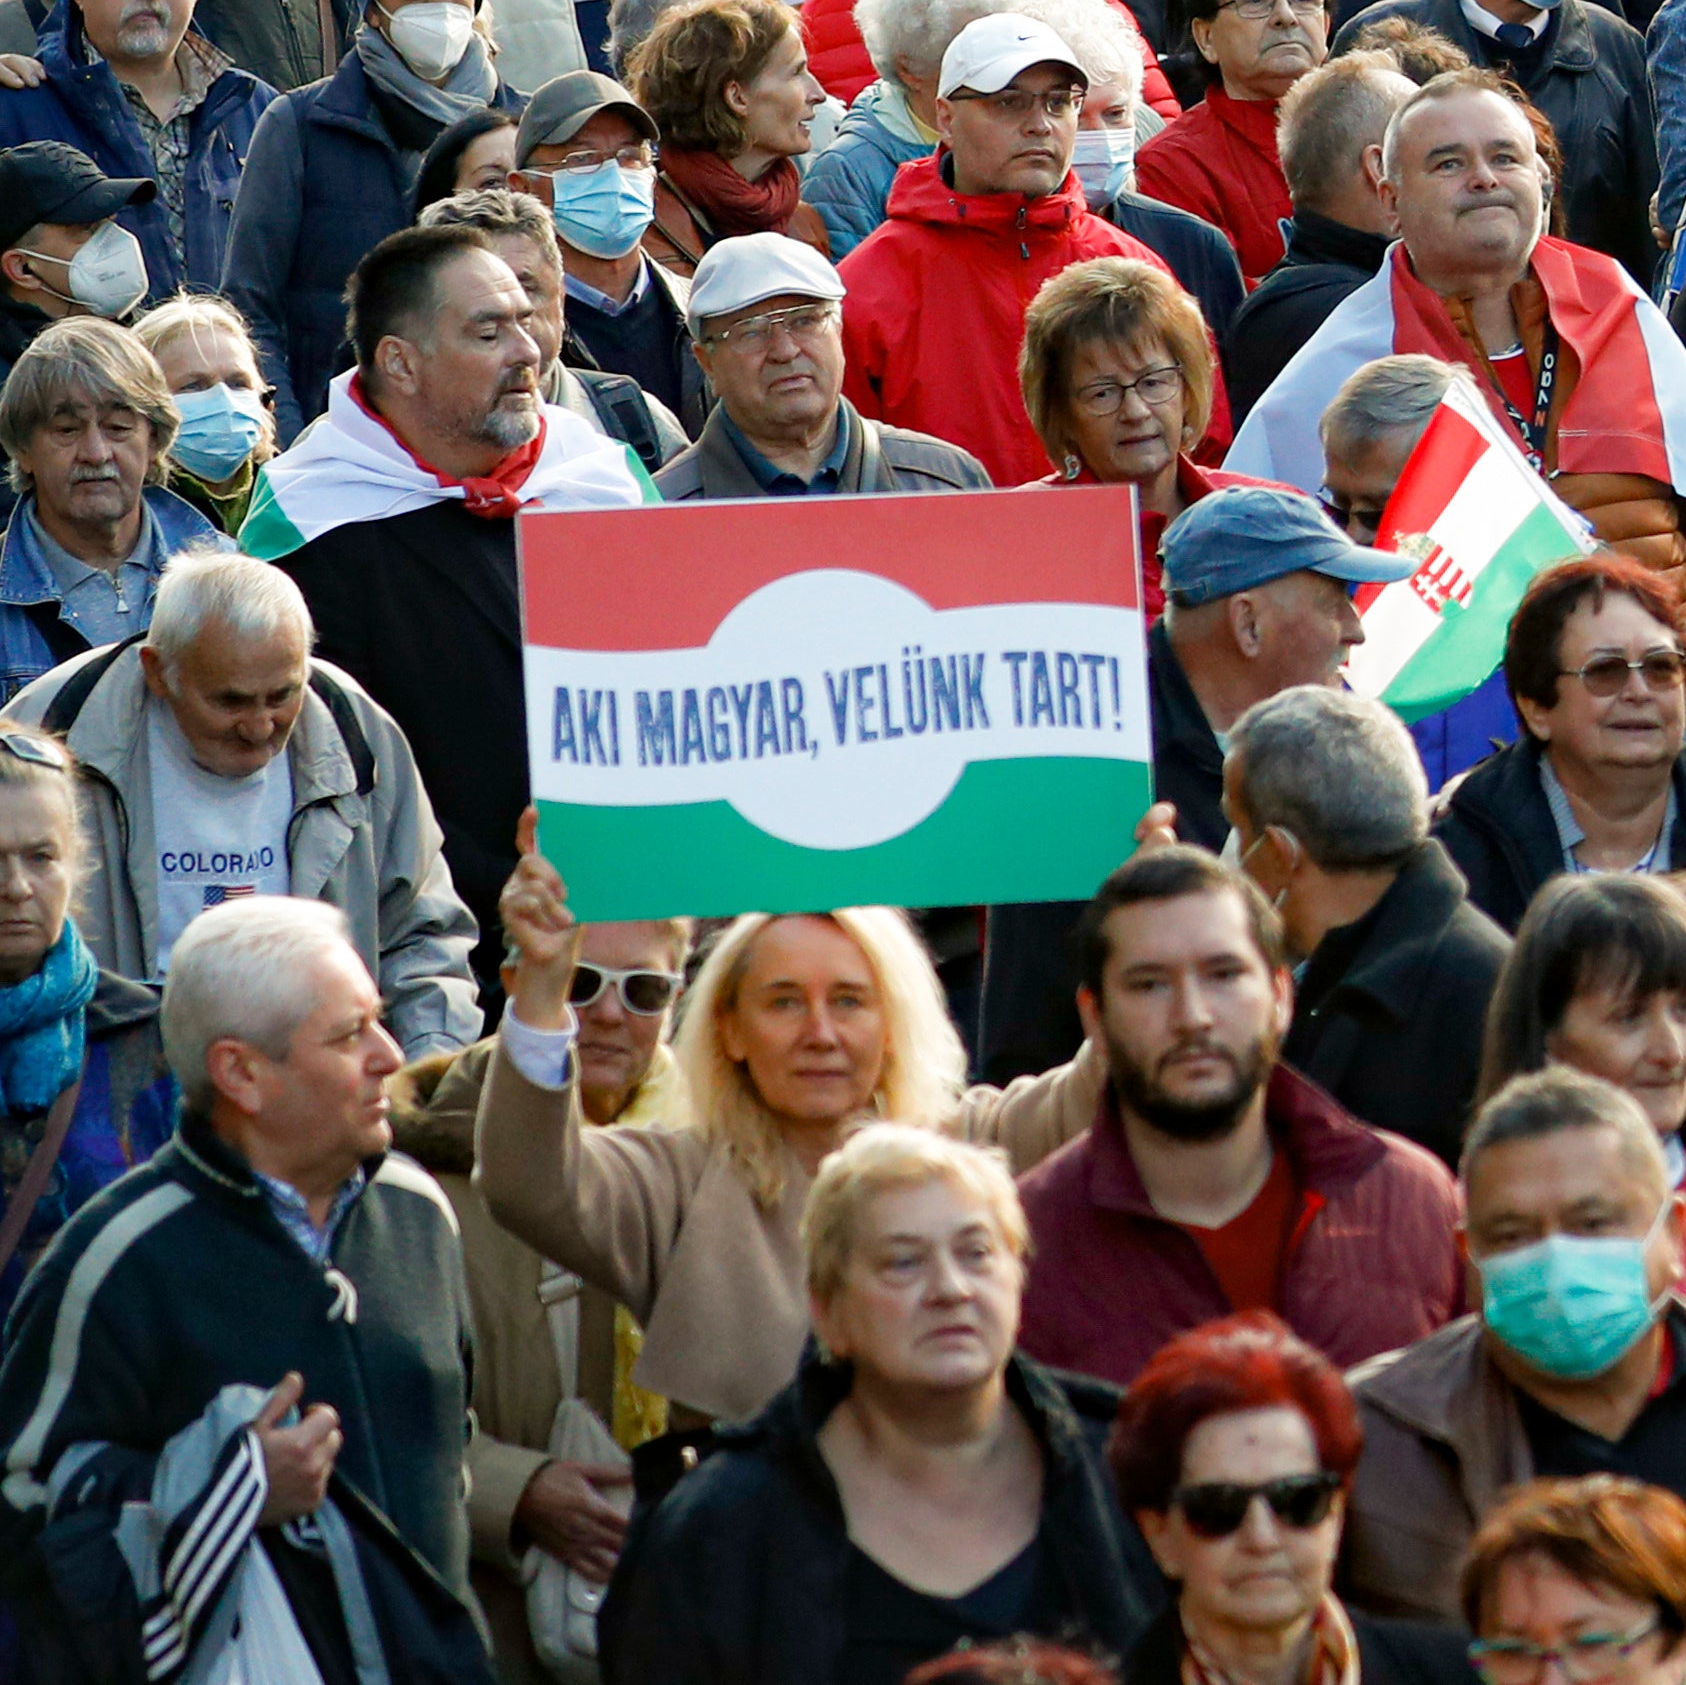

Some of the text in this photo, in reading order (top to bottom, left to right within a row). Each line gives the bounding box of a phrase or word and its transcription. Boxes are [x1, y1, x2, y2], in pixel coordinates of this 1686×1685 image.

[551, 646, 1123, 767] AKI MAGYAR, VELÜNK TART!
